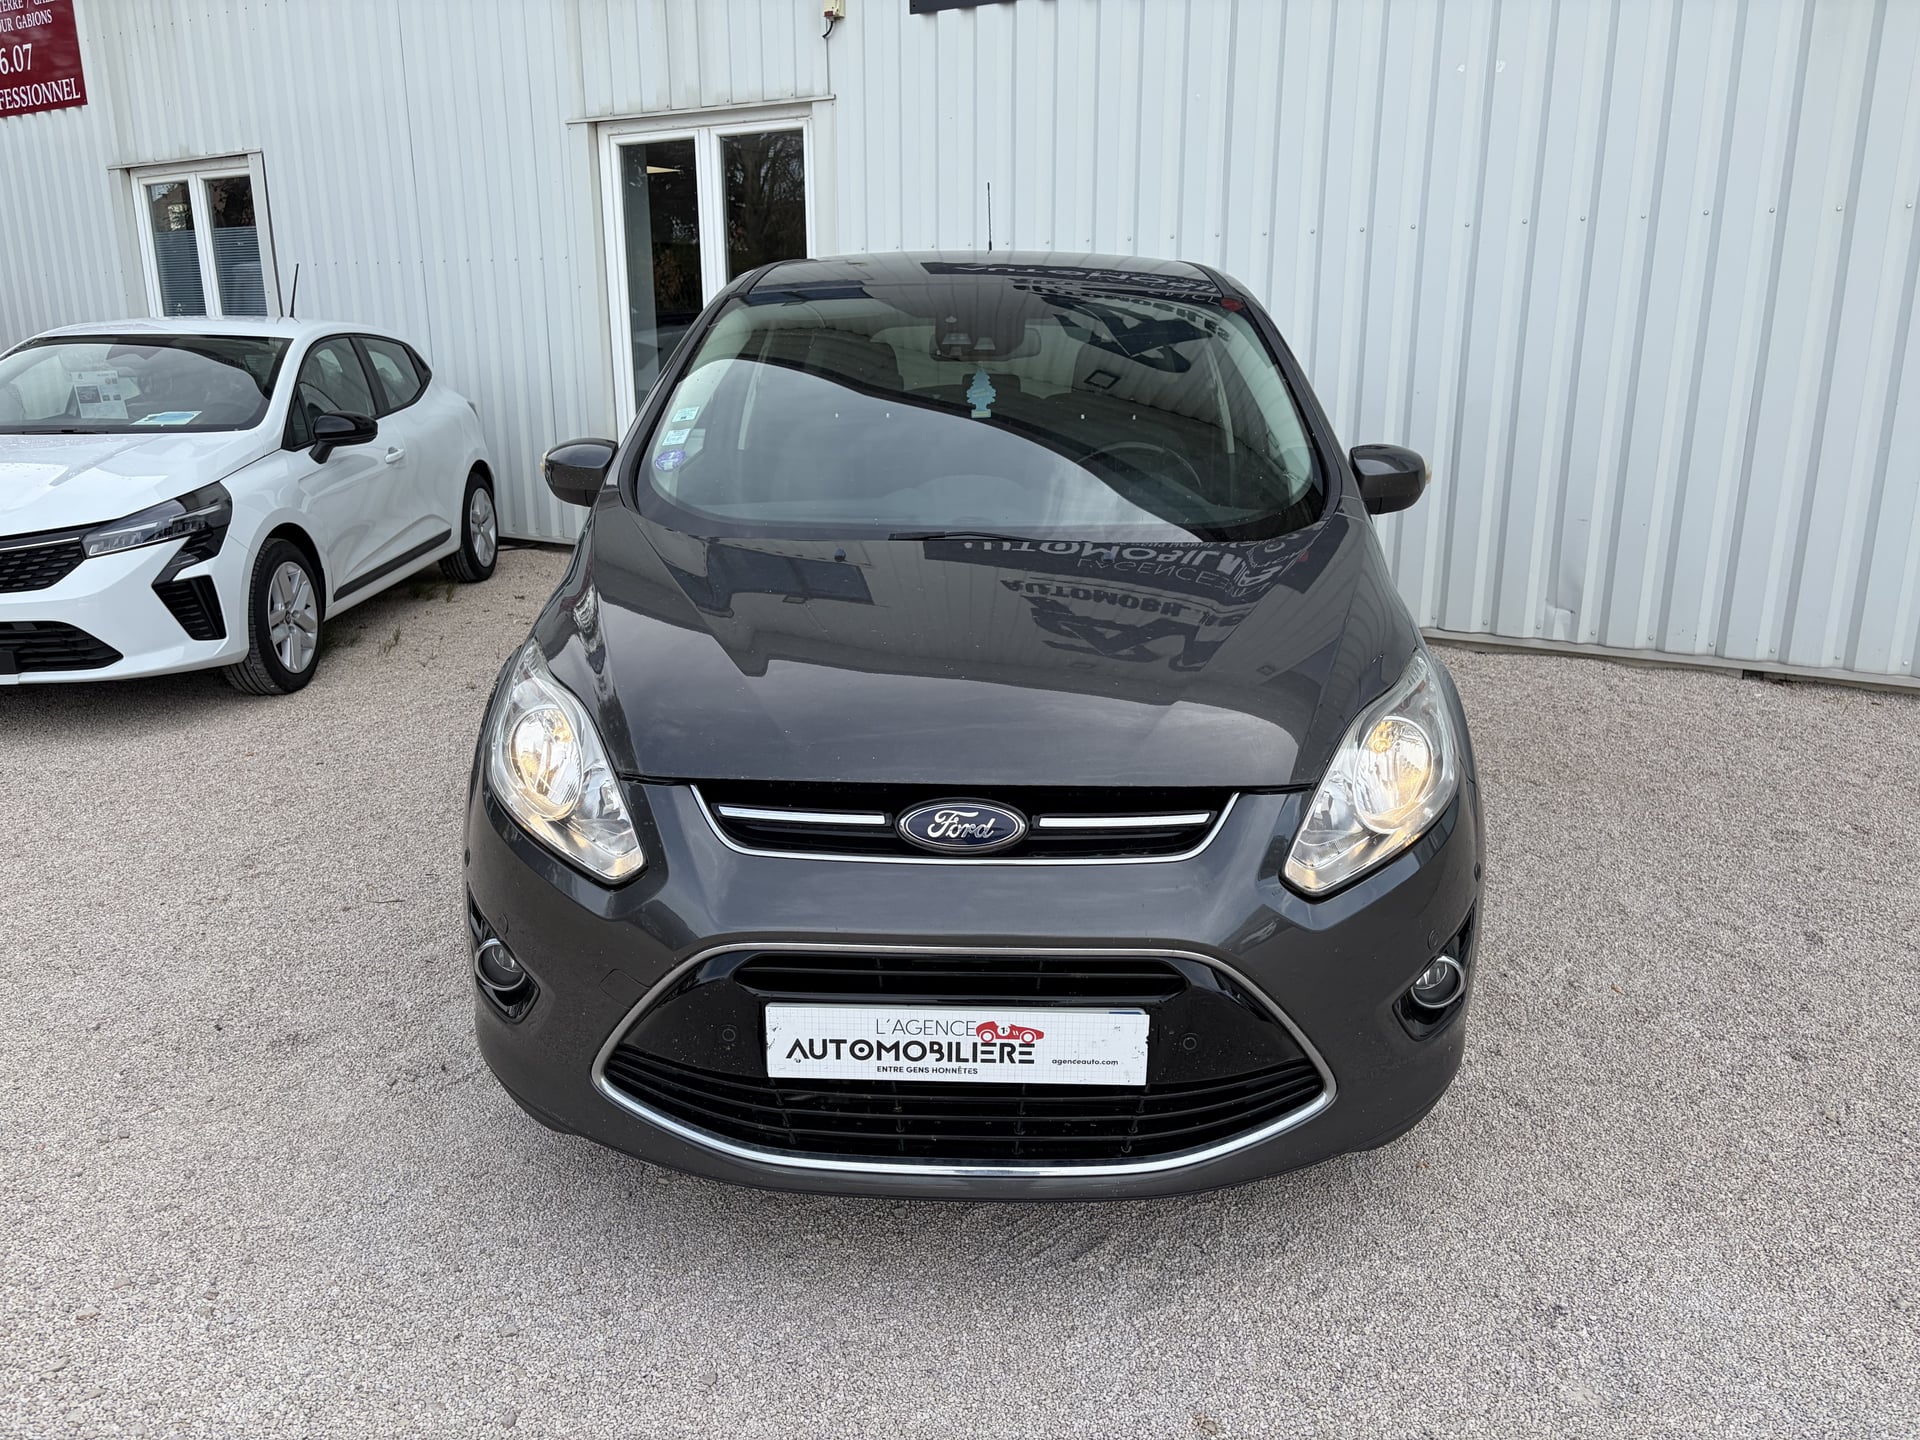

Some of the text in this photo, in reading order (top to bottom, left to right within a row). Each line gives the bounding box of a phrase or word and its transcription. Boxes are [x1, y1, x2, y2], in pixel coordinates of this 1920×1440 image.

[15, 8, 53, 30] GABIONS
[0, 43, 33, 75] 6.07
[927, 809, 996, 839] Ford
[876, 1018, 977, 1037] L'AGENCE
[876, 1065, 978, 1075] ENTRE GENS HONNÊTES
[1051, 1058, 1119, 1066] agenceauto.com
